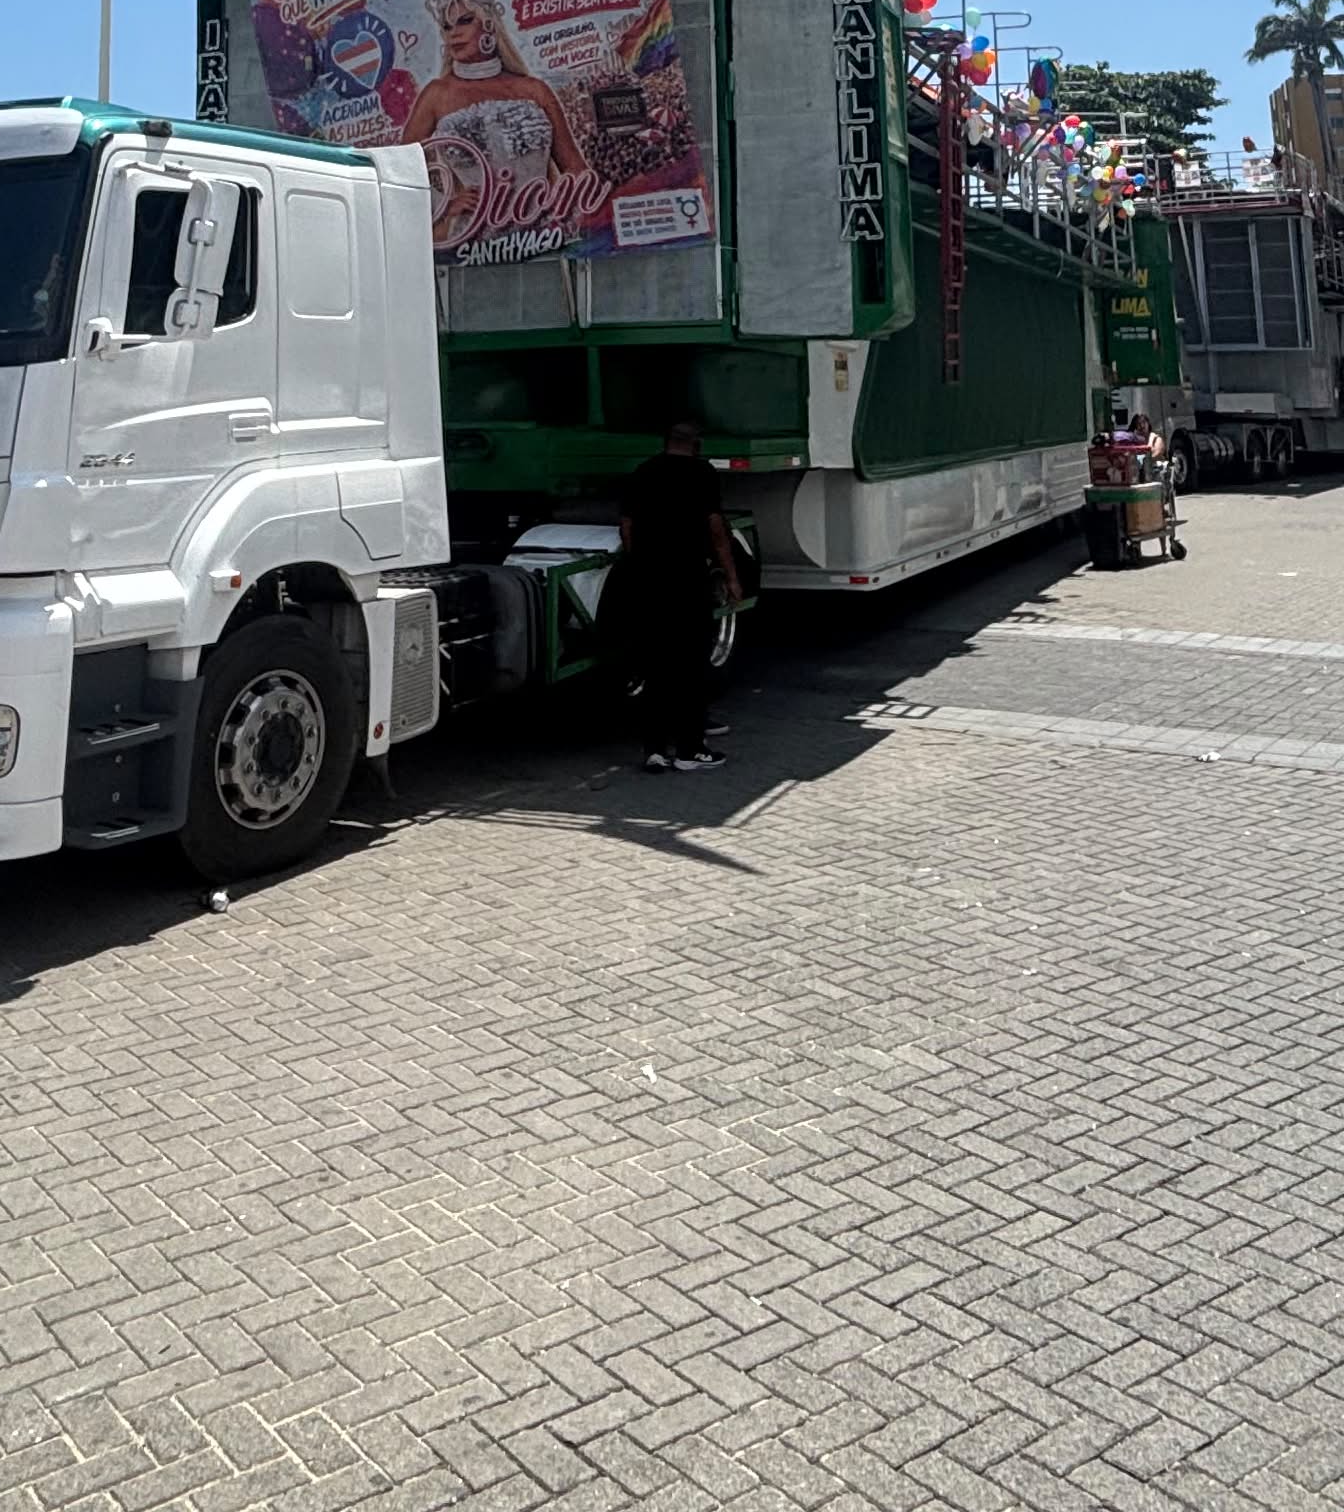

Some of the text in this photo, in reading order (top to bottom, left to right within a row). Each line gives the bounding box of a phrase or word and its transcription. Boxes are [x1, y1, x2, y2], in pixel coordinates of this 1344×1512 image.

[282, 0, 310, 20] QUE
[522, 0, 531, 20] É
[197, 19, 228, 122] IRA
[328, 126, 345, 143] AS
[456, 227, 563, 266] SANTHYAGO
[1111, 296, 1151, 317] LIMA
